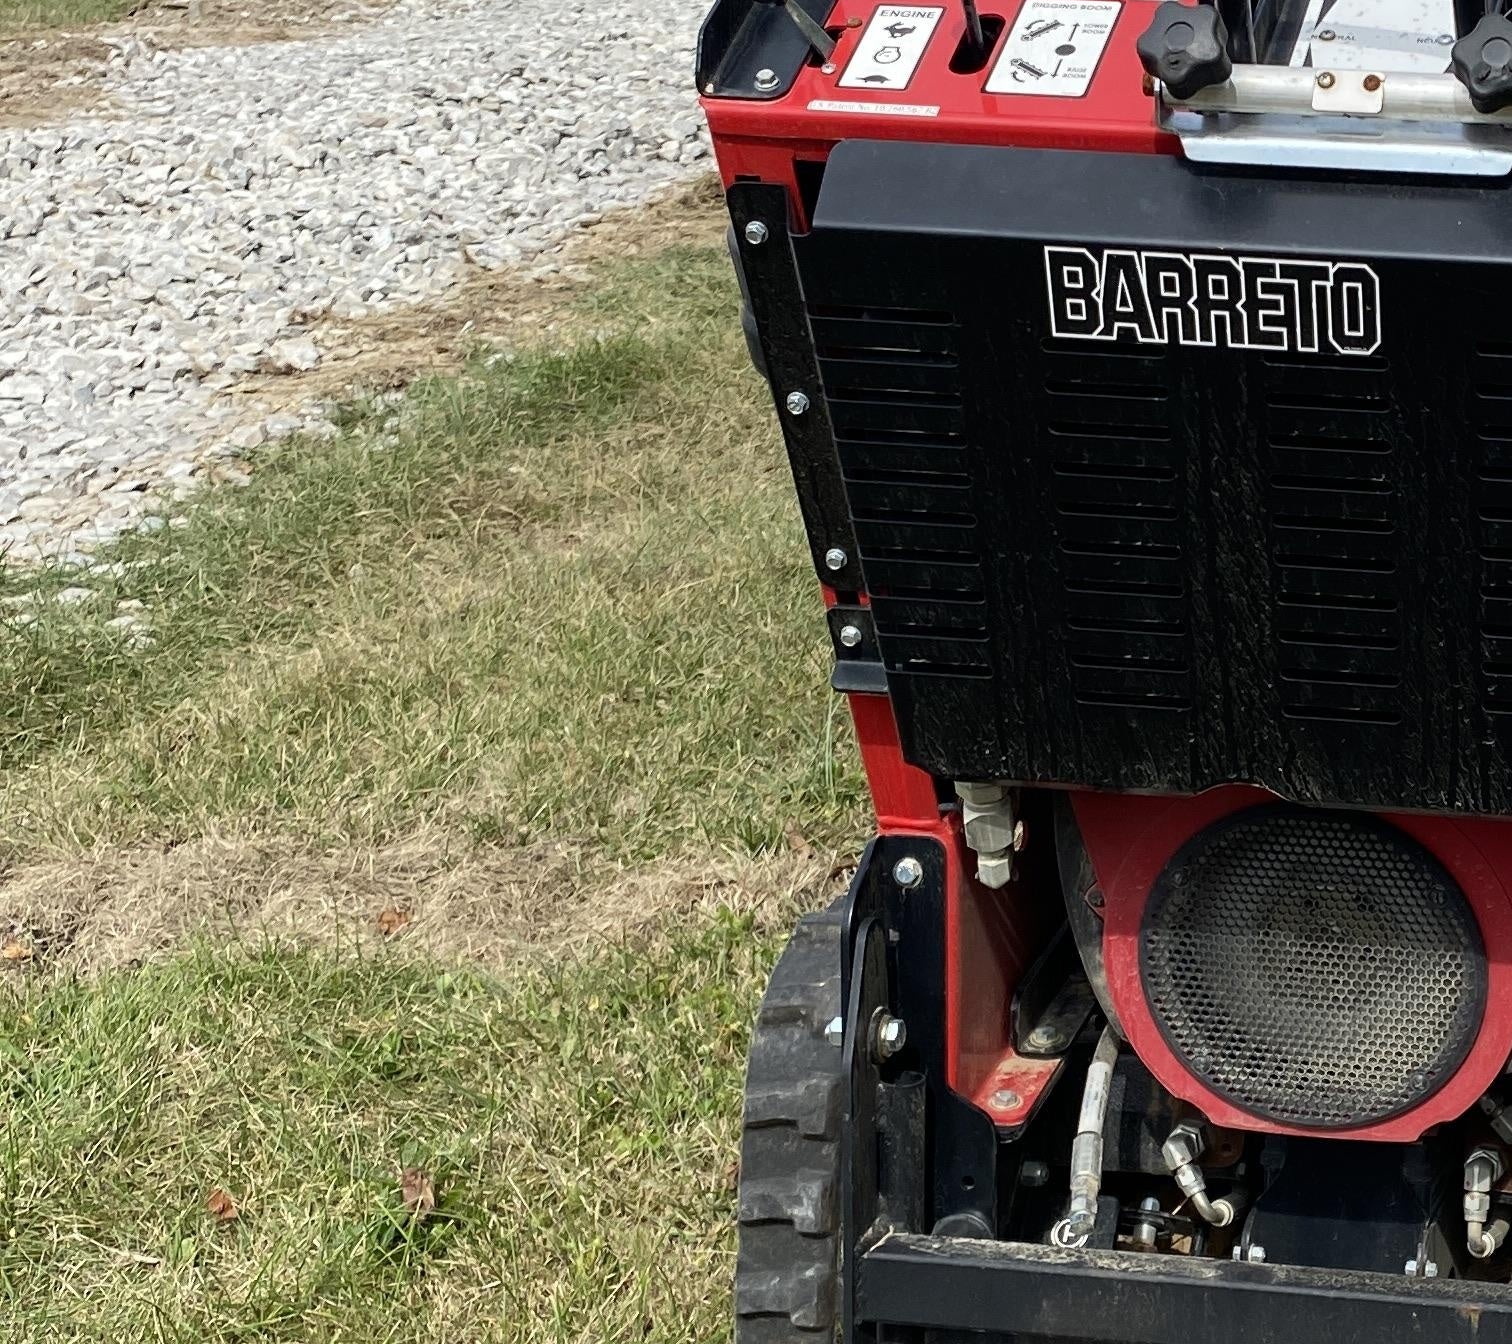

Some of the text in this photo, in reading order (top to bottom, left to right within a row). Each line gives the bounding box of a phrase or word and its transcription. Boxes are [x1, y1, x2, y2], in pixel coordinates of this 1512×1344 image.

[1032, 2, 1078, 10] DIGGING
[880, 9, 937, 19] ENGINE
[1043, 245, 1382, 356] BARRETO
